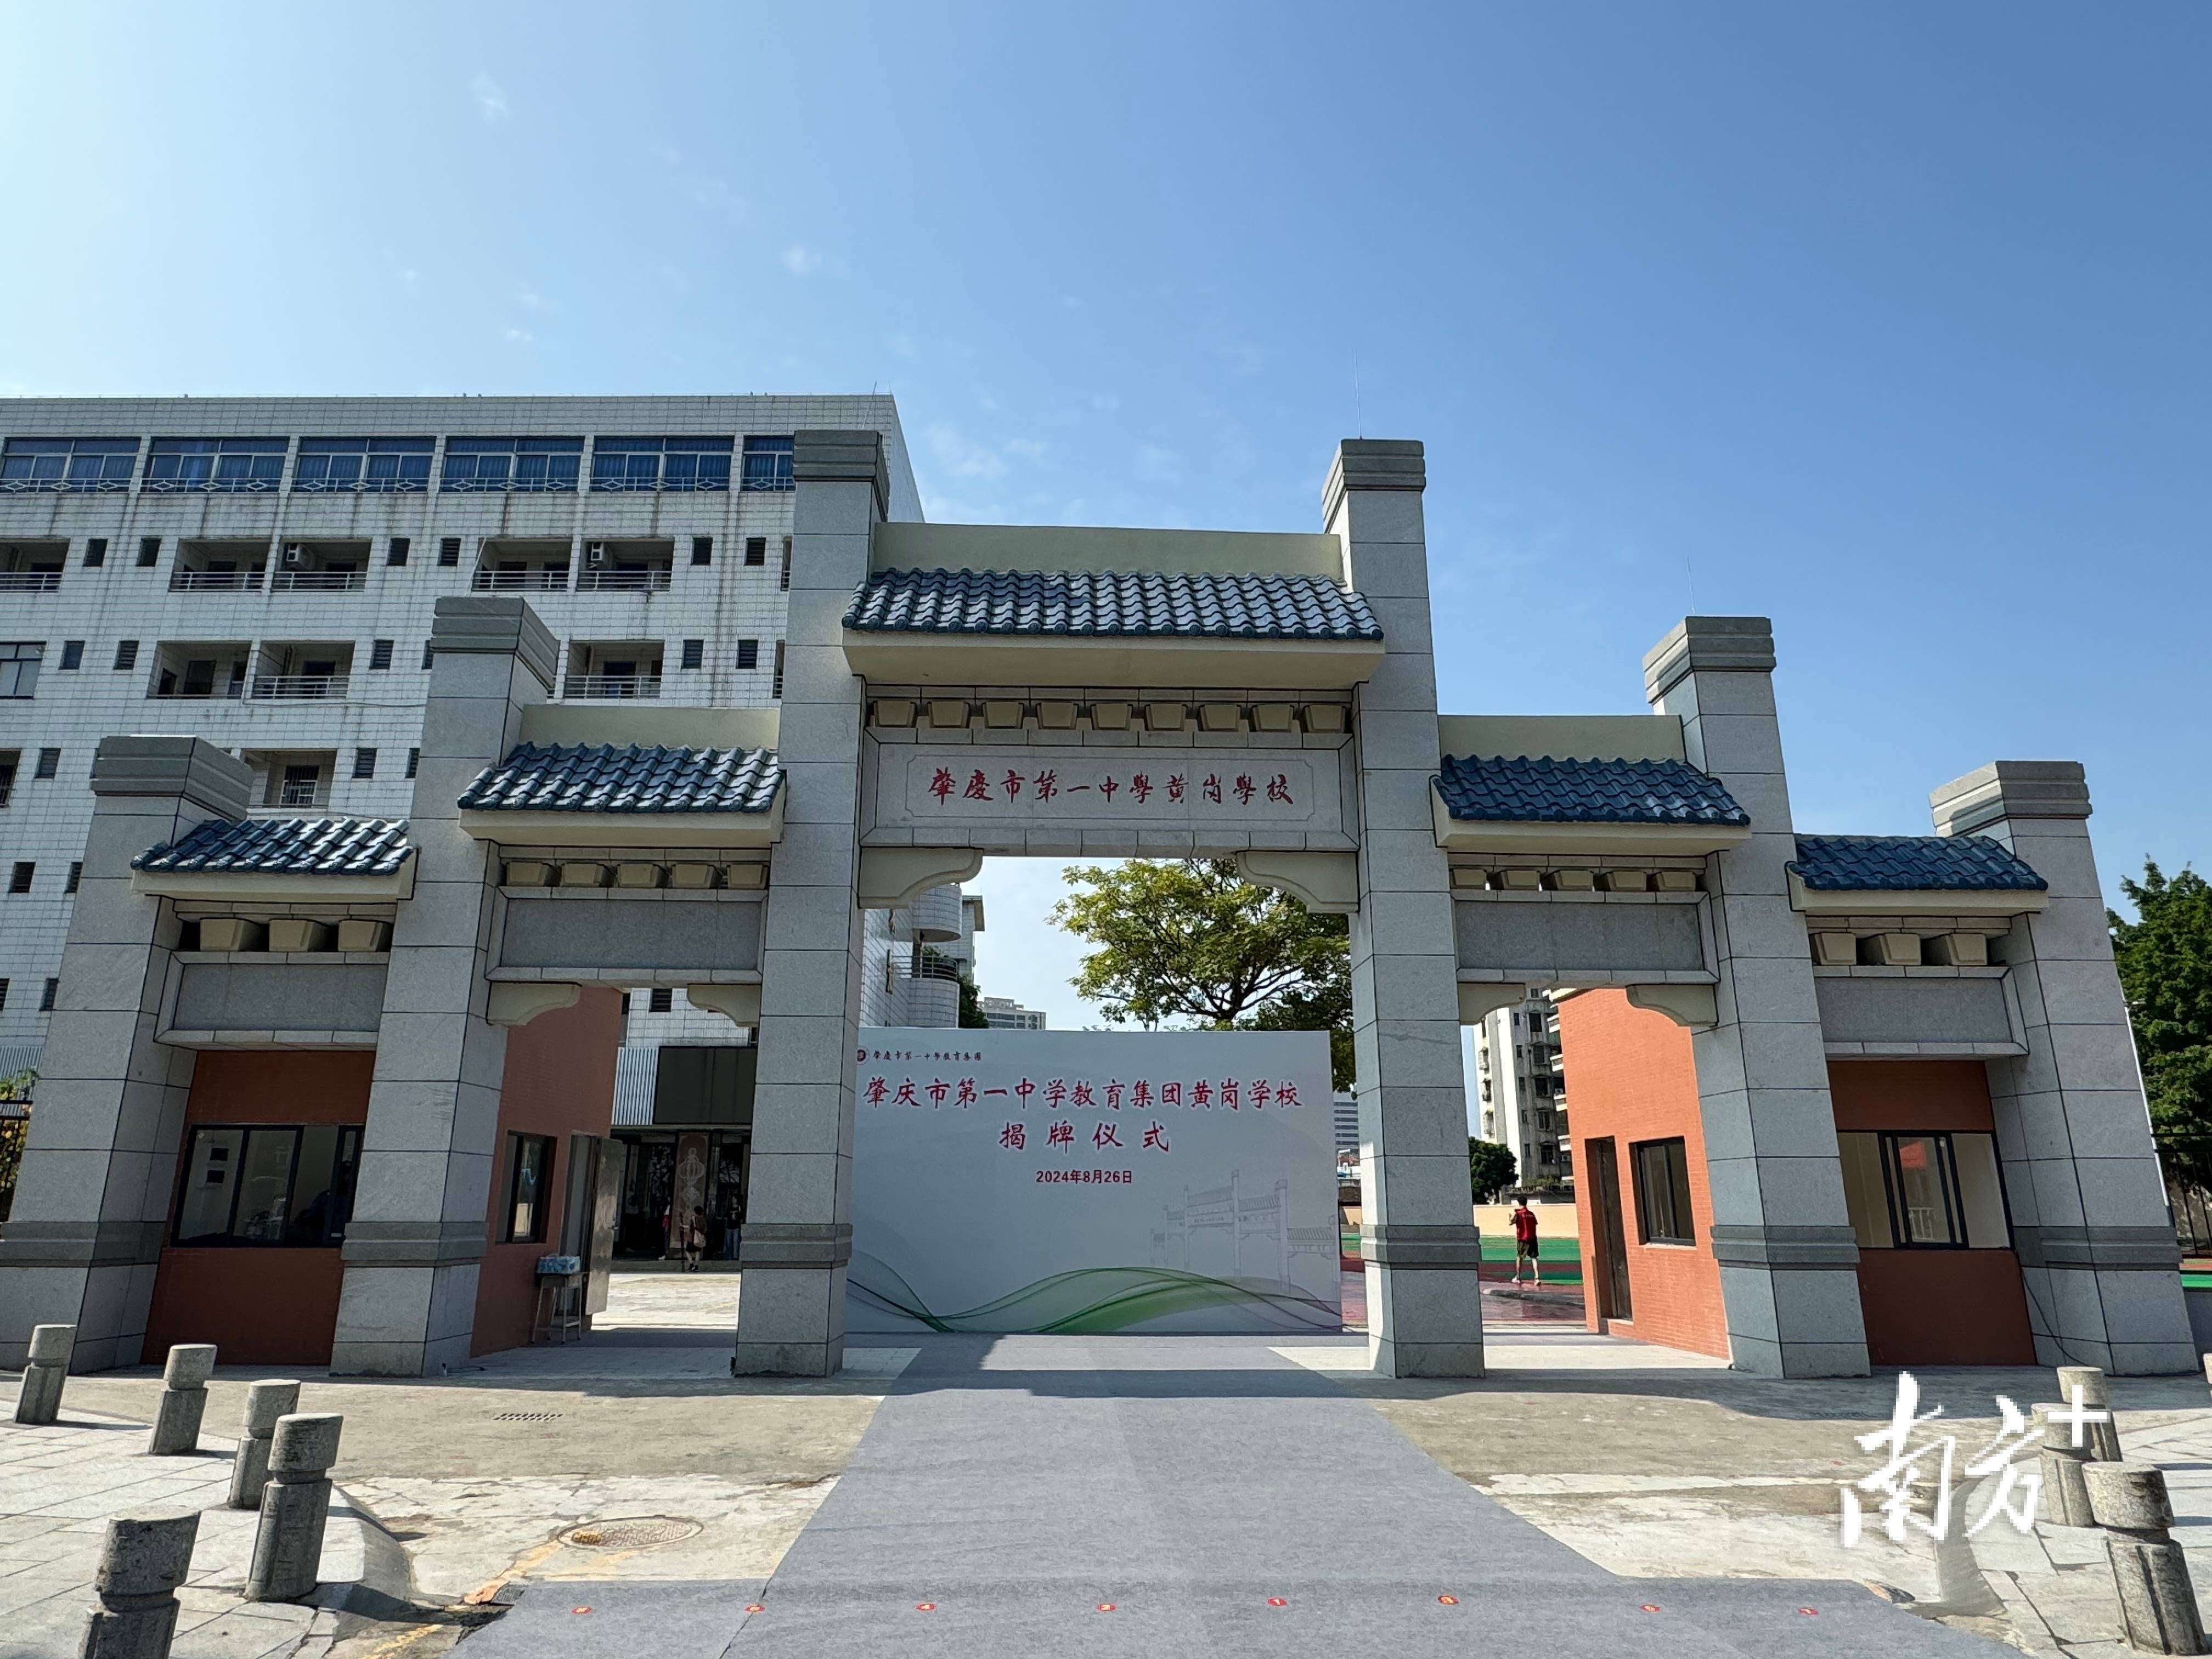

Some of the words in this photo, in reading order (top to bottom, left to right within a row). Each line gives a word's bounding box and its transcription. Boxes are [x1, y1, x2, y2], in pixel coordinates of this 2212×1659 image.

[863, 1076, 1303, 1110] 肇庆市第一中学教育集团黄岗学校
[998, 1120, 1170, 1154] 揭牌仪式
[1035, 1169, 1132, 1184] 2024年8月26日
